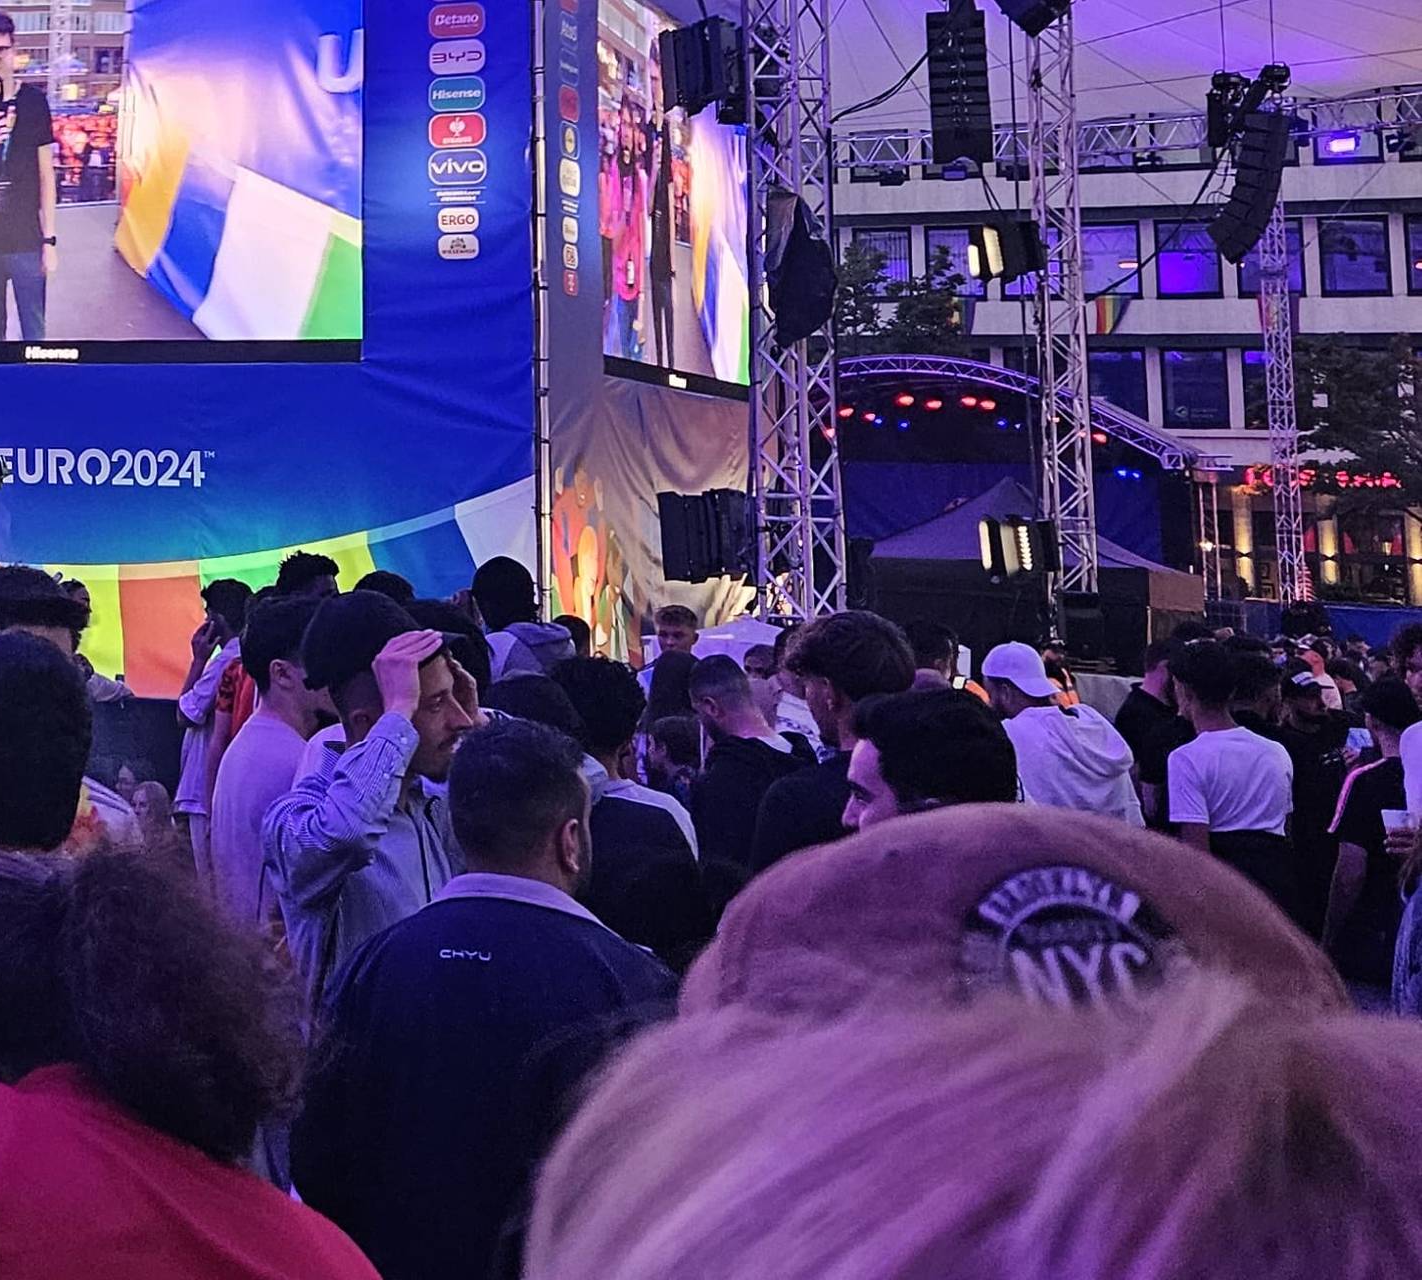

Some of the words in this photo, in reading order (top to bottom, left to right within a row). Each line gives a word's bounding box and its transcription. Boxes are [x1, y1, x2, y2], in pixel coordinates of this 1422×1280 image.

[435, 14, 479, 26] Betano
[432, 50, 482, 64] BYD
[432, 89, 482, 100] Hisense
[431, 158, 484, 175] vivo
[441, 215, 475, 226] ERGO
